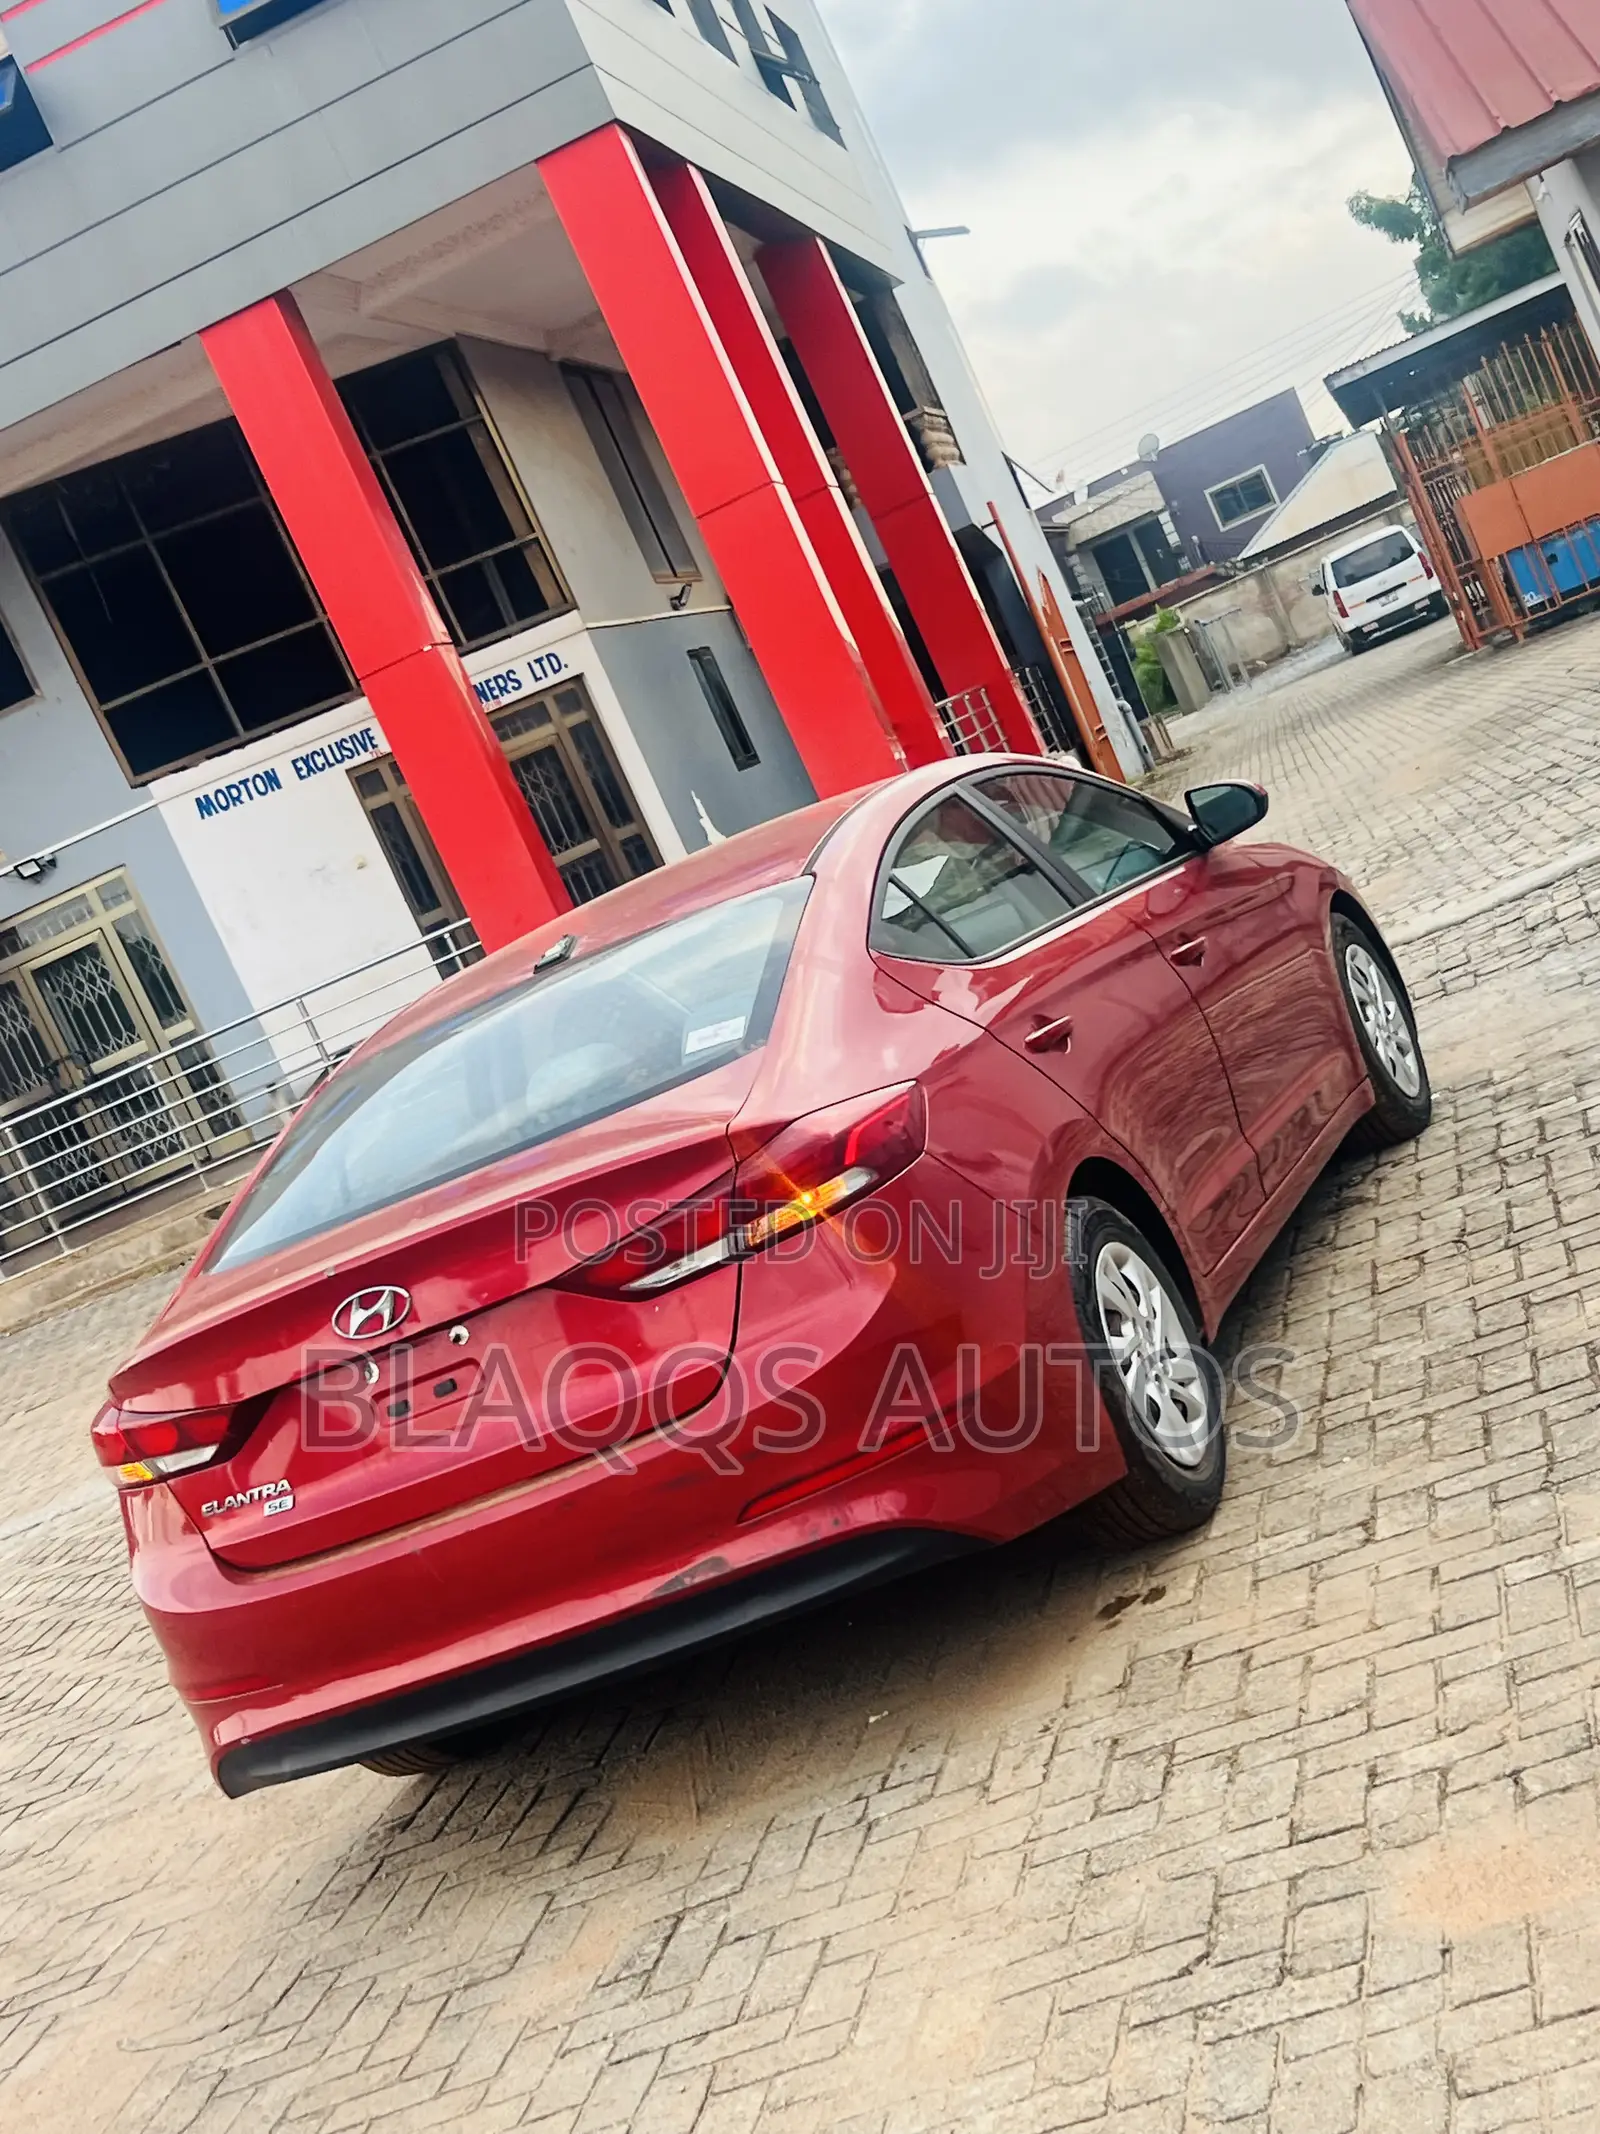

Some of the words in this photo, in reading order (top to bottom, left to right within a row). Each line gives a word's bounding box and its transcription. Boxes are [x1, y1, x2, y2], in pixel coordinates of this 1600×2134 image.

[195, 768, 283, 819] MORTON
[291, 727, 378, 781] EXCLUSIVE
[527, 652, 569, 682] LTD.
[201, 1479, 292, 1517] ELANTRA
[268, 1499, 289, 1513] SE
